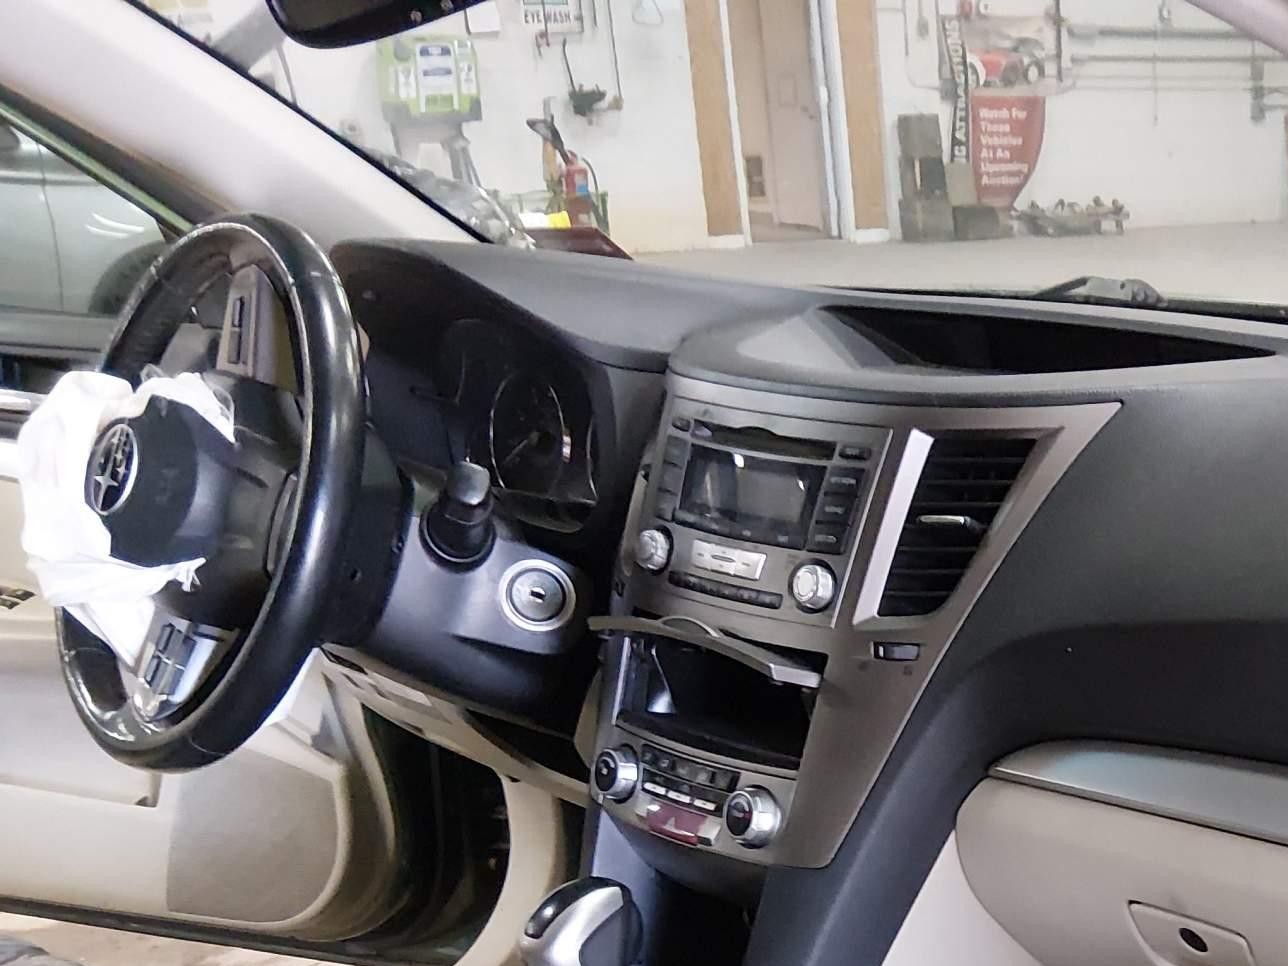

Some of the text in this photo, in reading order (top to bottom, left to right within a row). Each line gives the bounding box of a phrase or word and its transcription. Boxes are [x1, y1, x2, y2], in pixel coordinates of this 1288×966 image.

[524, 9, 542, 24] EYE
[545, 9, 572, 24] WASH
[945, 18, 967, 142] ATTRACTIONS
[979, 107, 1028, 119] Watch For
[980, 121, 1010, 132] These
[980, 134, 1023, 145] Vehicles
[980, 148, 1011, 159] At An
[981, 161, 1028, 175] Upcoming
